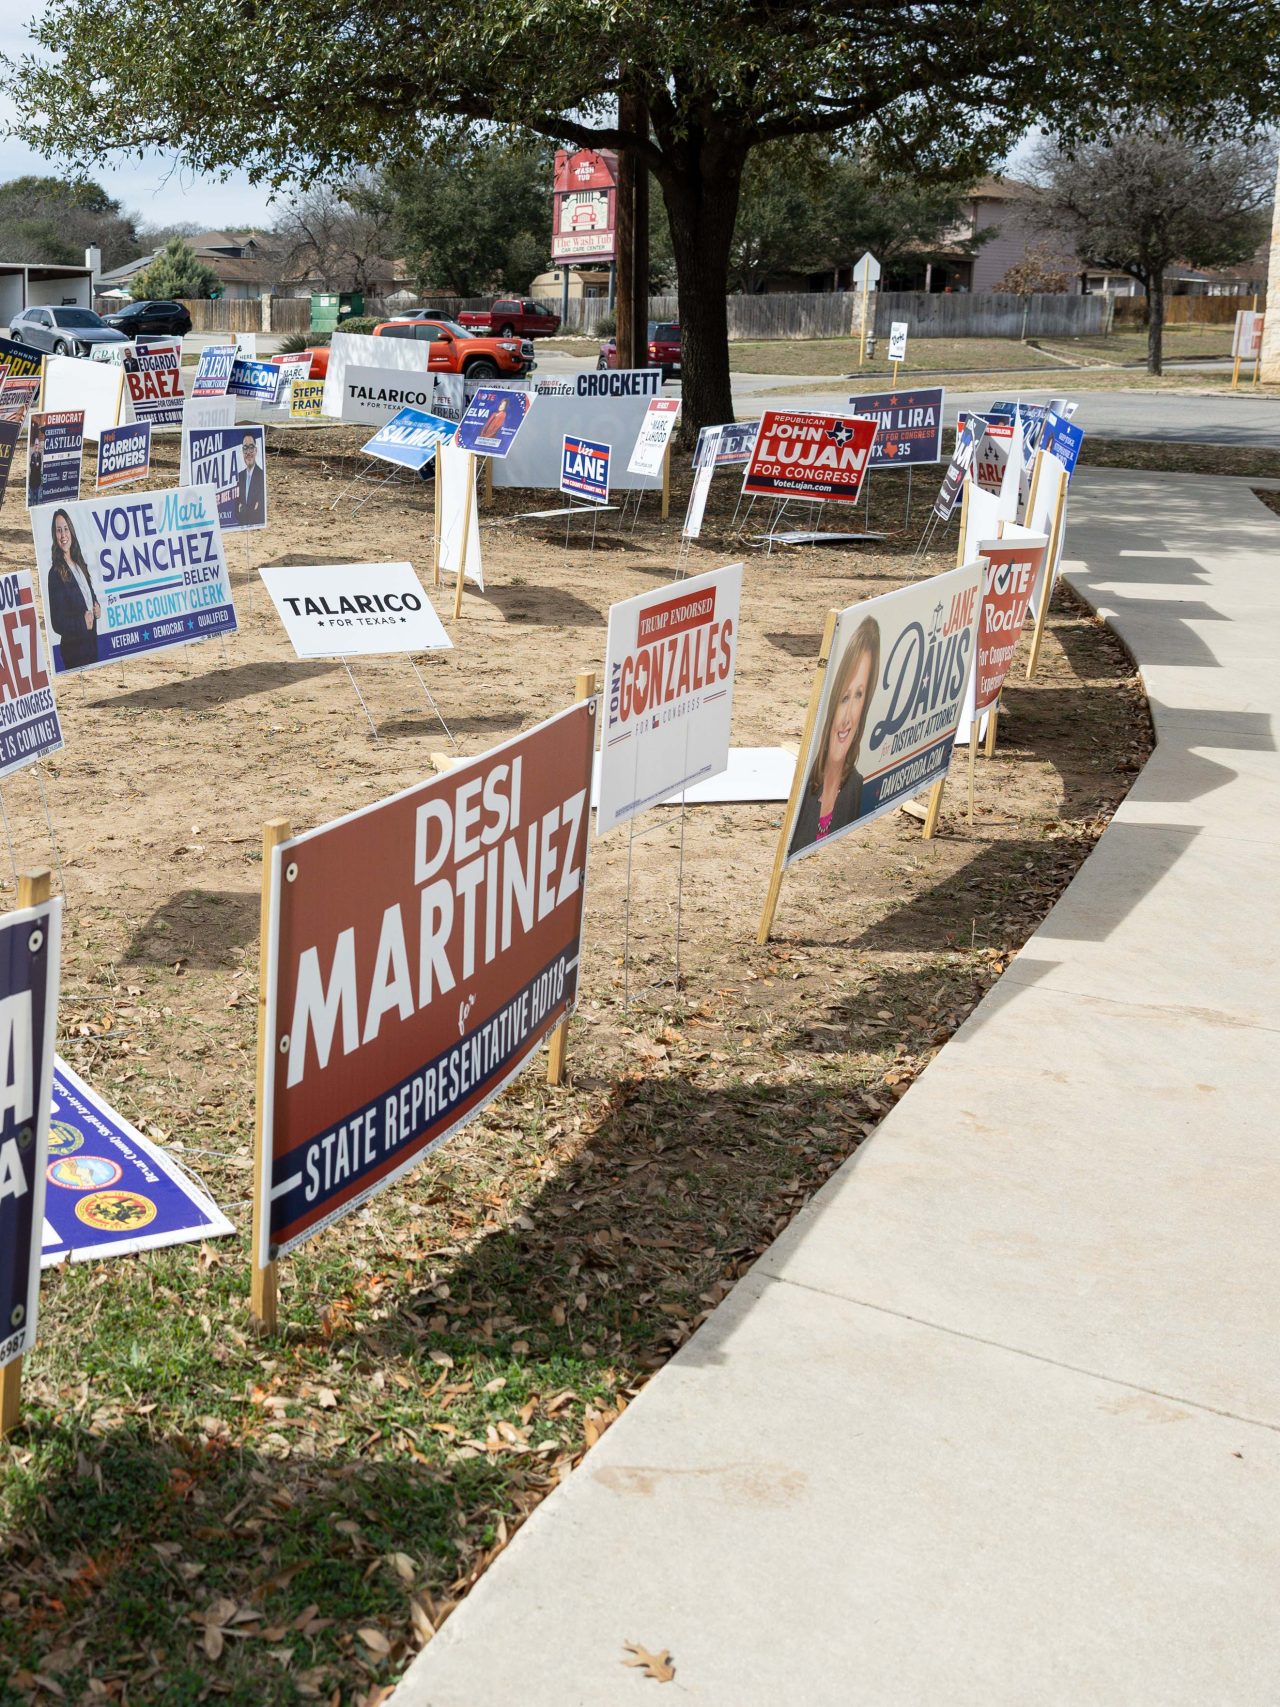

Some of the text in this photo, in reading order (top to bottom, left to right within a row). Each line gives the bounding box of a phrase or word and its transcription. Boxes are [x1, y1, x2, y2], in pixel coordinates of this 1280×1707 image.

[575, 167, 594, 175] WASH
[557, 234, 611, 248] The Wash Tub
[9, 349, 38, 361] JOHNNY
[139, 354, 177, 372] EDGARDO
[127, 369, 185, 402] BAEZ
[348, 385, 427, 405] TALARICO
[577, 372, 660, 396] CROCKETT
[437, 396, 451, 404] PETE
[47, 413, 83, 425] DEMOCRAT
[467, 408, 490, 418] ELVA
[775, 415, 826, 426] REPUBLICAN
[44, 435, 81, 450] CASTILLO
[45, 428, 66, 436] CHRISTINE
[764, 424, 823, 442] JOHN
[886, 430, 935, 441] FOR CONGRESS
[103, 432, 146, 458] CARRIÓN
[192, 432, 223, 460] RYAN
[757, 439, 867, 470] LUJAN
[872, 443, 911, 457] TX 35
[101, 450, 146, 473] POWERS
[565, 451, 605, 481] LANE
[753, 463, 858, 483] FOR CONGRESS
[773, 479, 832, 492] VoteLujan.com
[91, 494, 208, 543] VOTE Mari
[100, 531, 218, 583] SANCHEZ
[107, 583, 226, 629] BEXAR COUNTY CLERK
[283, 592, 422, 616] TALARICO
[640, 597, 713, 636] TRUMP ENDORSED
[943, 585, 978, 638] JANE
[111, 611, 229, 649] VETERAN DEMOCRAT QUALIFIED
[330, 616, 396, 627] FOR TEXAS
[985, 603, 1016, 633] Rod
[619, 618, 733, 722] GONZALES
[609, 662, 621, 729] TONY
[870, 621, 970, 751] DAVIS
[1, 688, 54, 727] FOR CONGRESS
[7, 737, 16, 758] IS
[18, 718, 57, 754] COMING!
[414, 755, 523, 886] DESI
[287, 788, 587, 1089] MARTINEZ
[305, 1110, 377, 1202] STATE
[385, 995, 530, 1151] REPRESENTATIVE
[530, 956, 566, 1028] HD118
